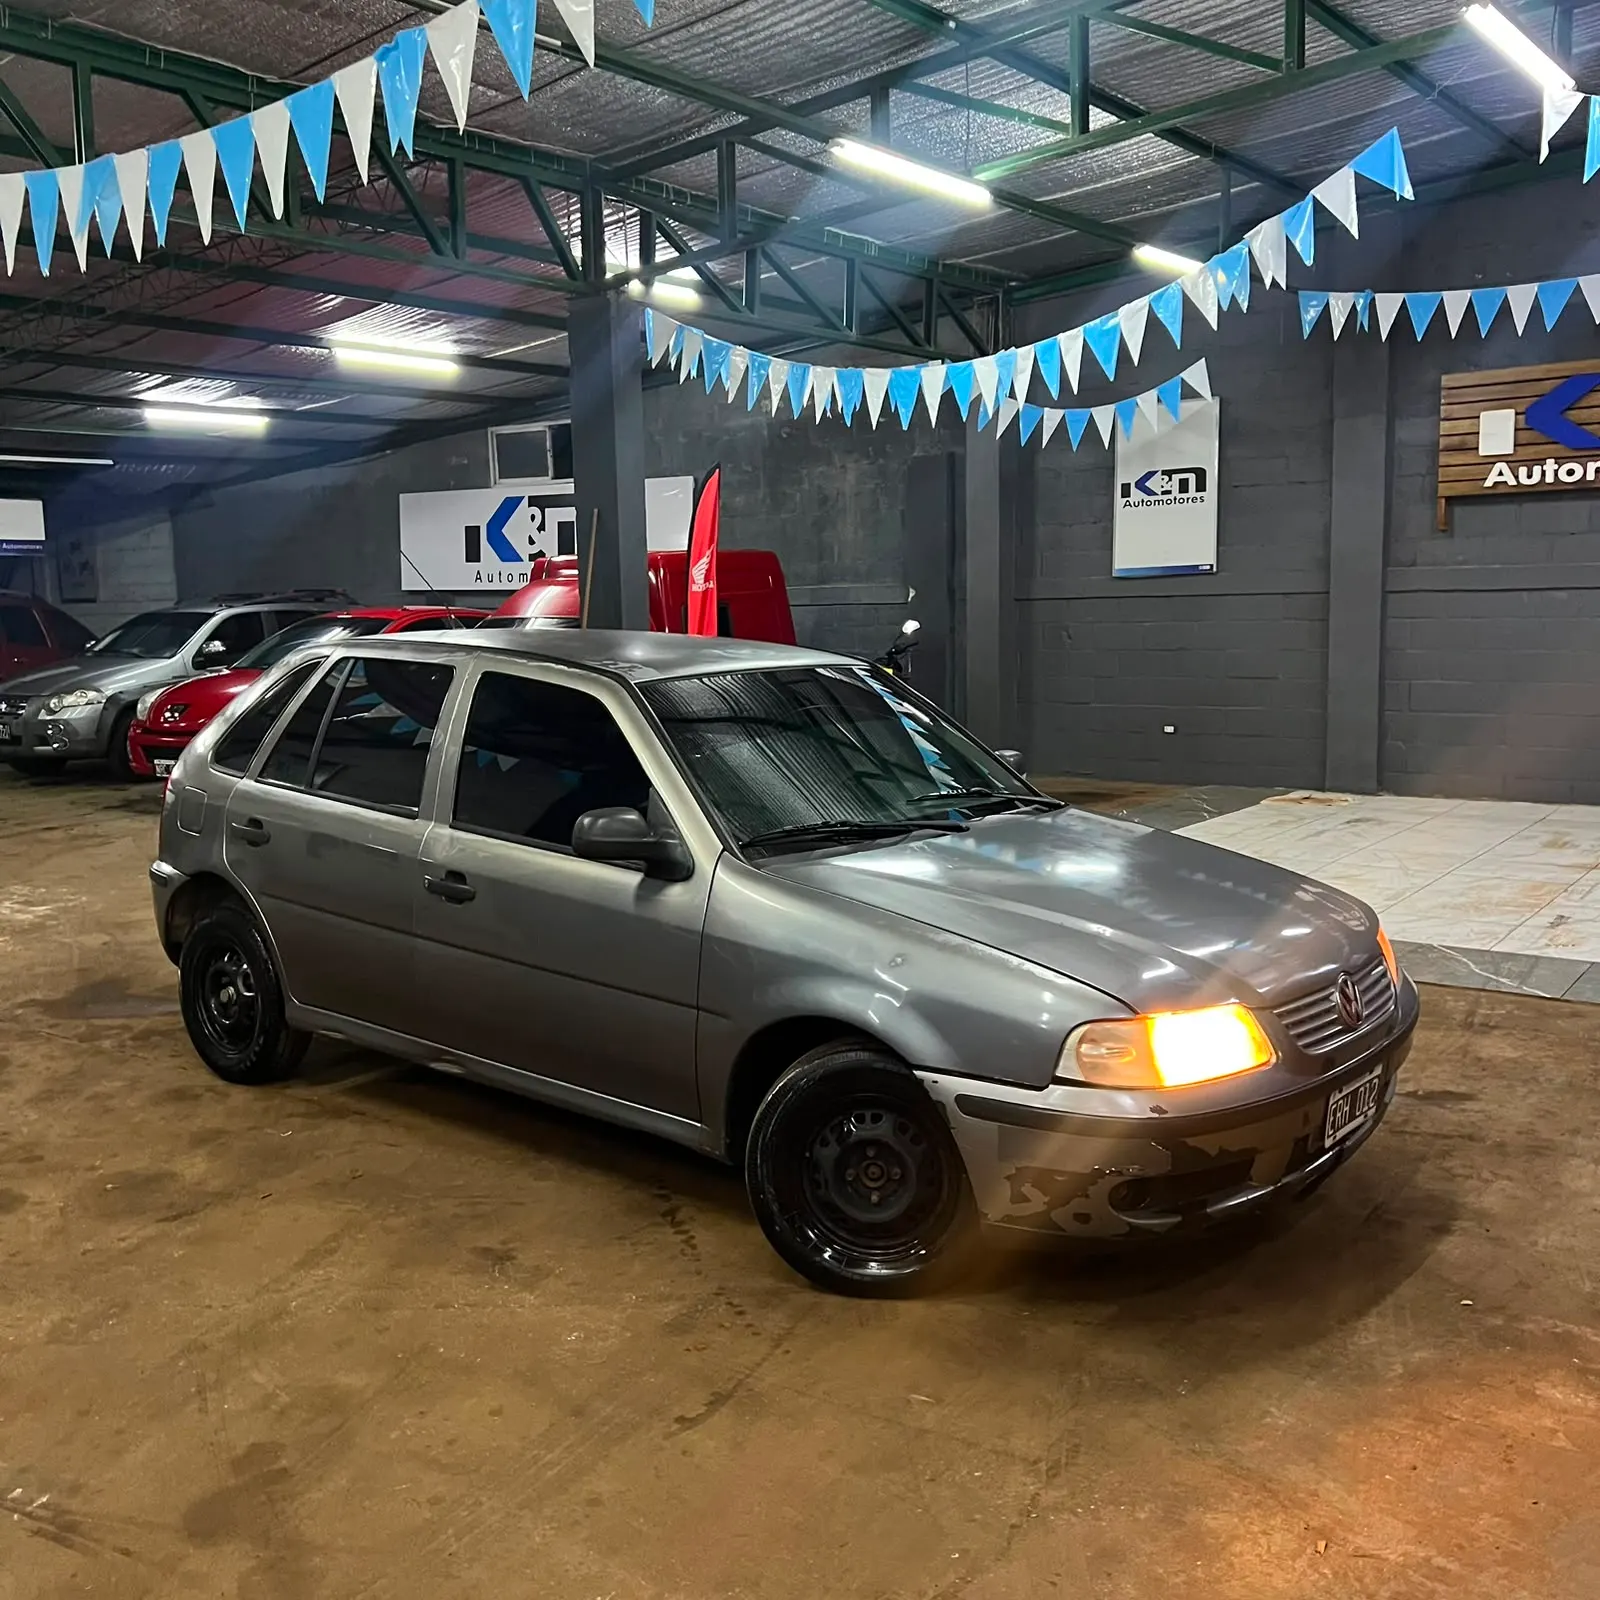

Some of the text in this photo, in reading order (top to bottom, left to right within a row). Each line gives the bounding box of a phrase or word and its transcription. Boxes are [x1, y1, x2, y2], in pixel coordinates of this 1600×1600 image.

[1123, 495, 1206, 509] Automotores
[1329, 1078, 1379, 1135] ERH 012
